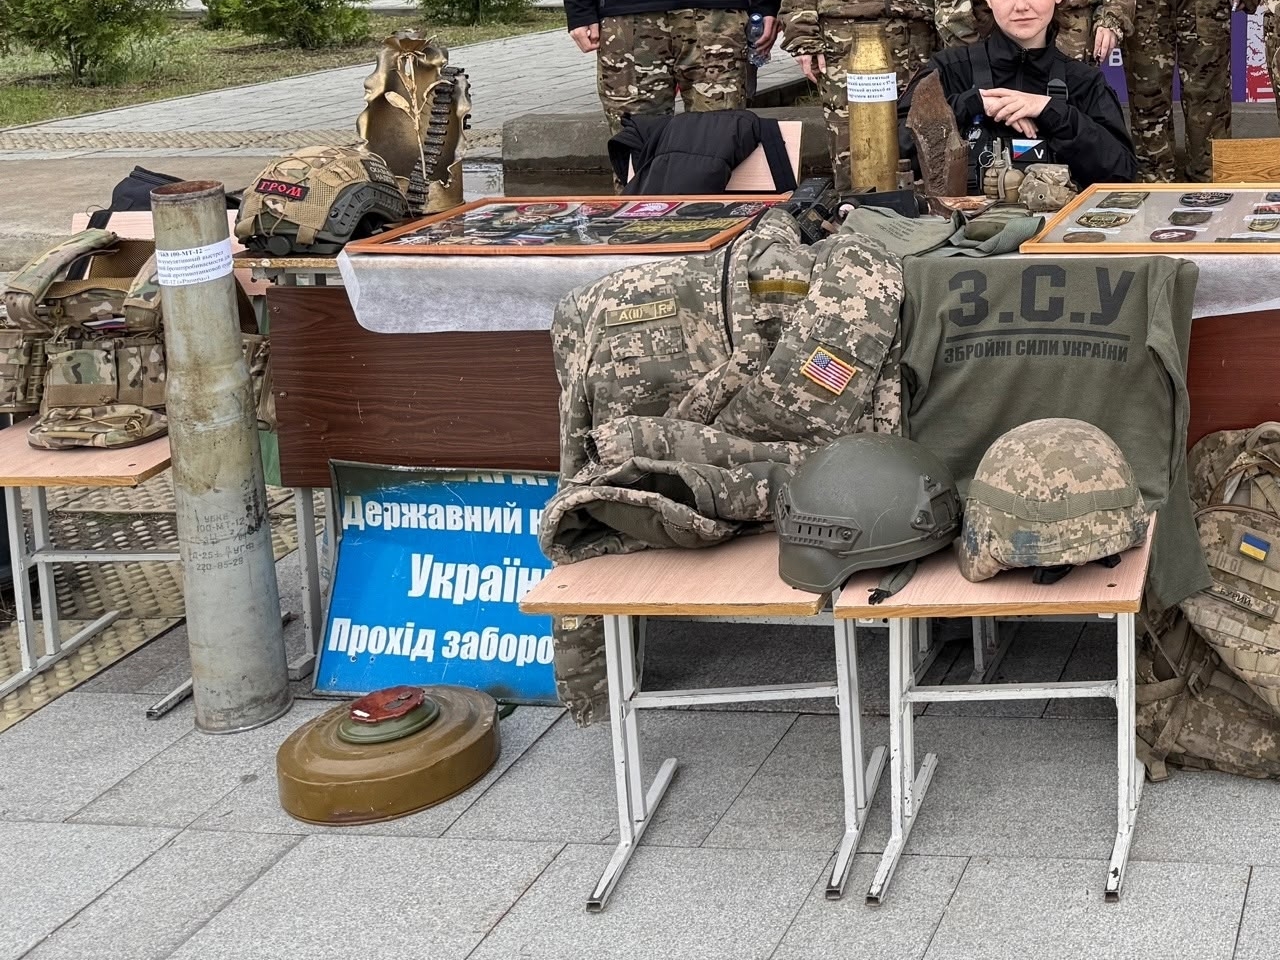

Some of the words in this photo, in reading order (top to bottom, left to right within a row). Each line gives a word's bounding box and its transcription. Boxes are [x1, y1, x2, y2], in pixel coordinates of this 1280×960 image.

[258, 181, 302, 198] ГРОМ
[948, 264, 1136, 327] З.С.У
[944, 339, 1012, 364] ЗБРОЙНІ
[1015, 339, 1058, 356] СИЛИ
[1062, 340, 1129, 363] УКРАЇНИ
[342, 495, 522, 534] Державний
[408, 553, 552, 605] Україн
[328, 617, 436, 662] Прохід
[442, 627, 555, 667] заборо
